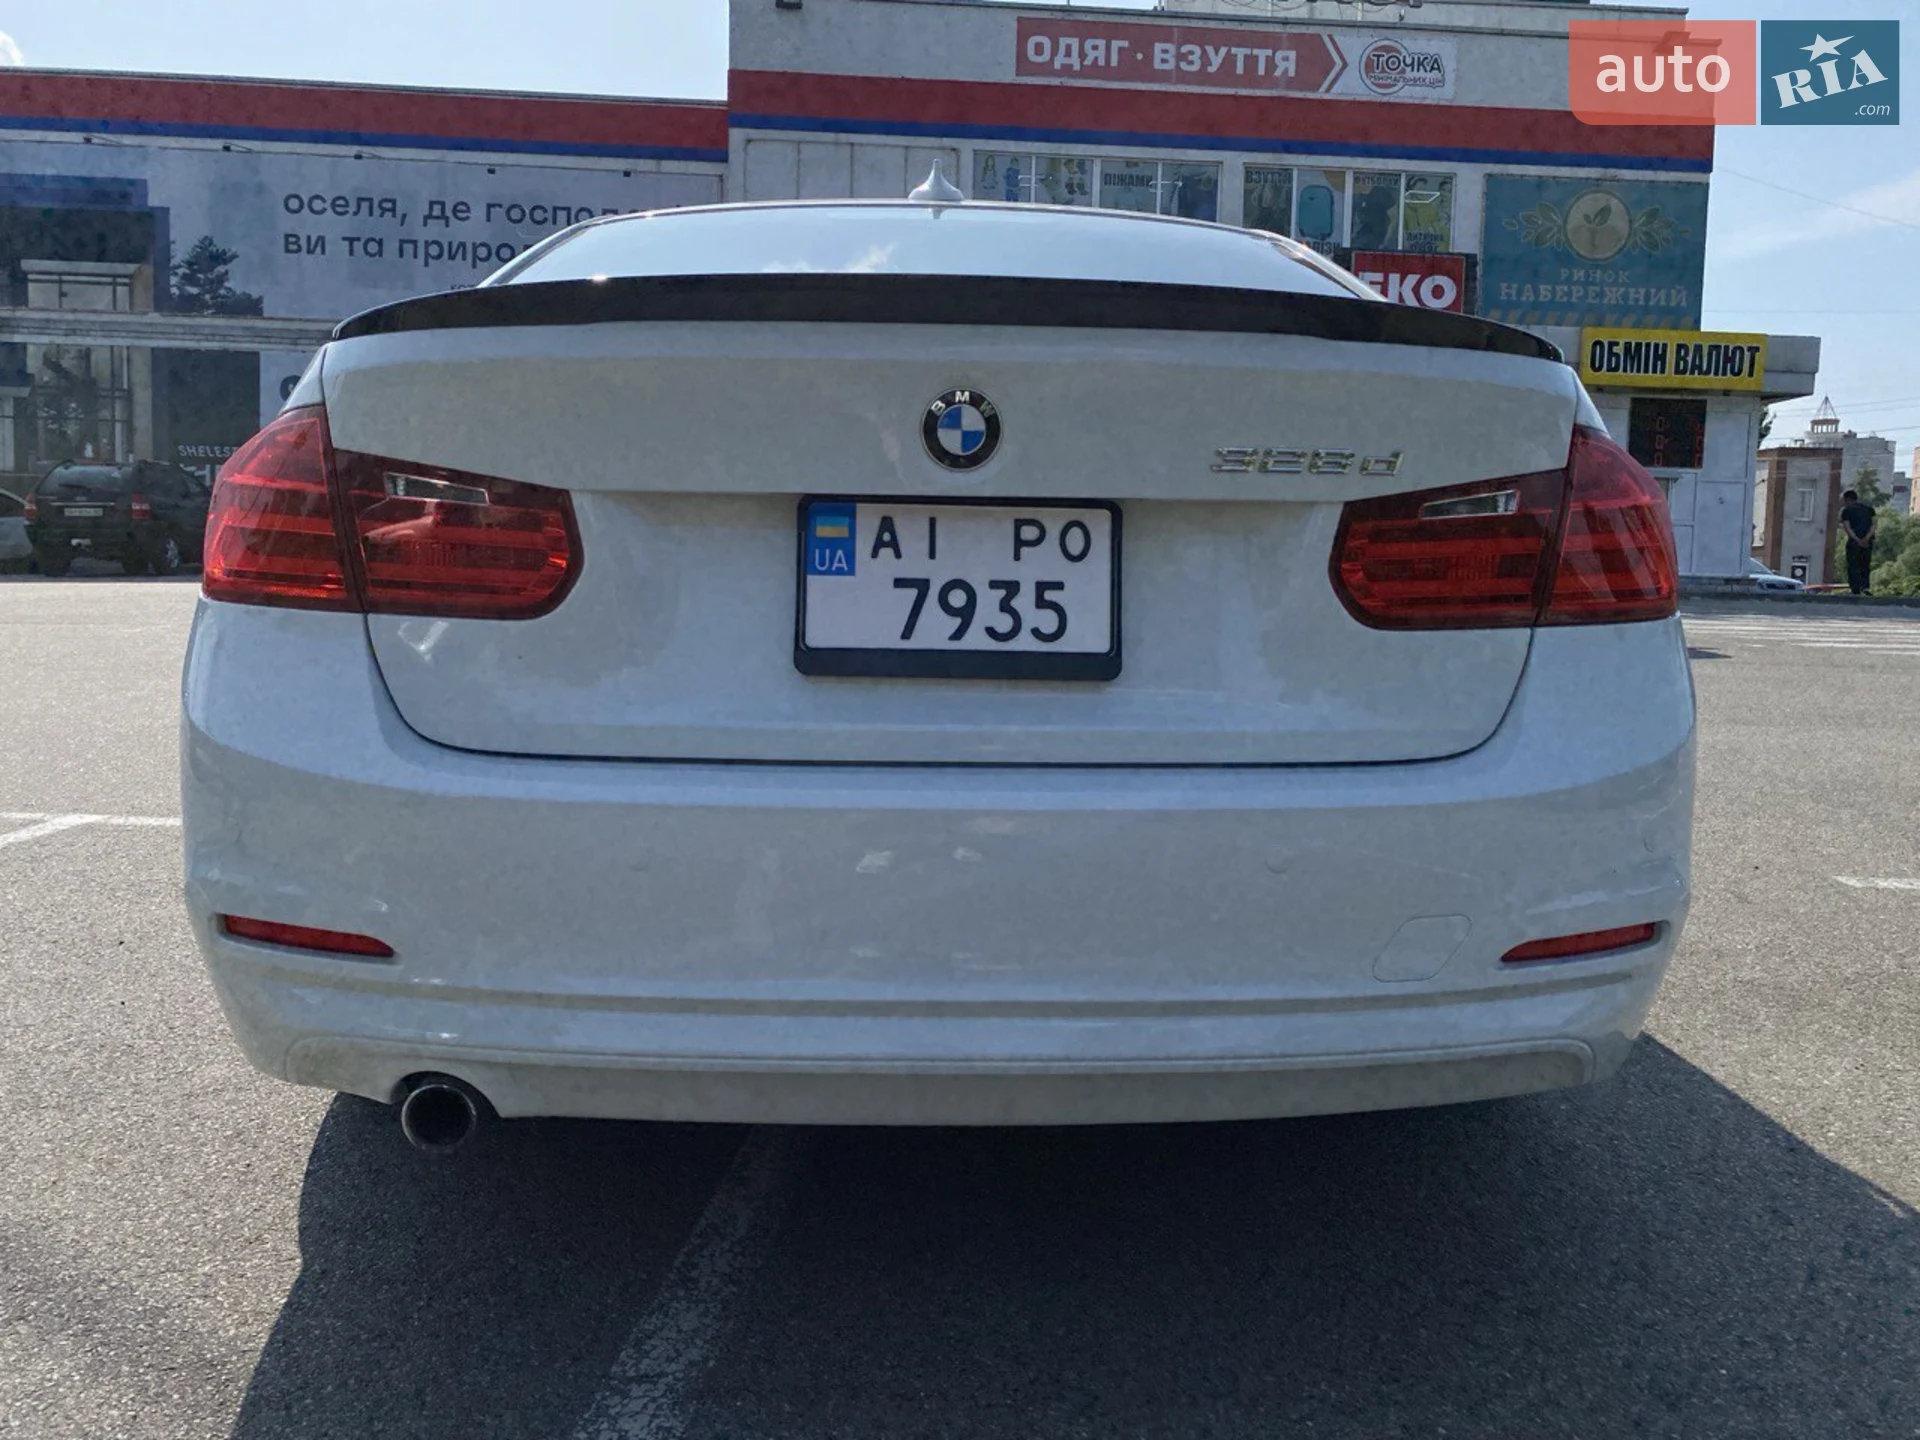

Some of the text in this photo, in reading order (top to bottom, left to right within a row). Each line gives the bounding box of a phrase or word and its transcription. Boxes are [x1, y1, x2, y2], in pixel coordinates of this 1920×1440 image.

[1026, 35, 1297, 77] ОДЯГ ВЗУТТЯ
[1372, 53, 1442, 74] ТОЧКА
[283, 192, 407, 228] оселя,
[422, 199, 472, 229] де
[283, 232, 534, 270] ви та приро
[1560, 267, 1632, 283] РИНОК
[1499, 282, 1688, 308] НАБЕРЕЖНИЙ
[1589, 339, 1761, 379] ОБМІН ВАЛЮТ
[930, 390, 996, 418] BMW
[870, 515, 1092, 563] AI PO
[814, 548, 849, 572] UA
[892, 577, 1068, 643] 7935
